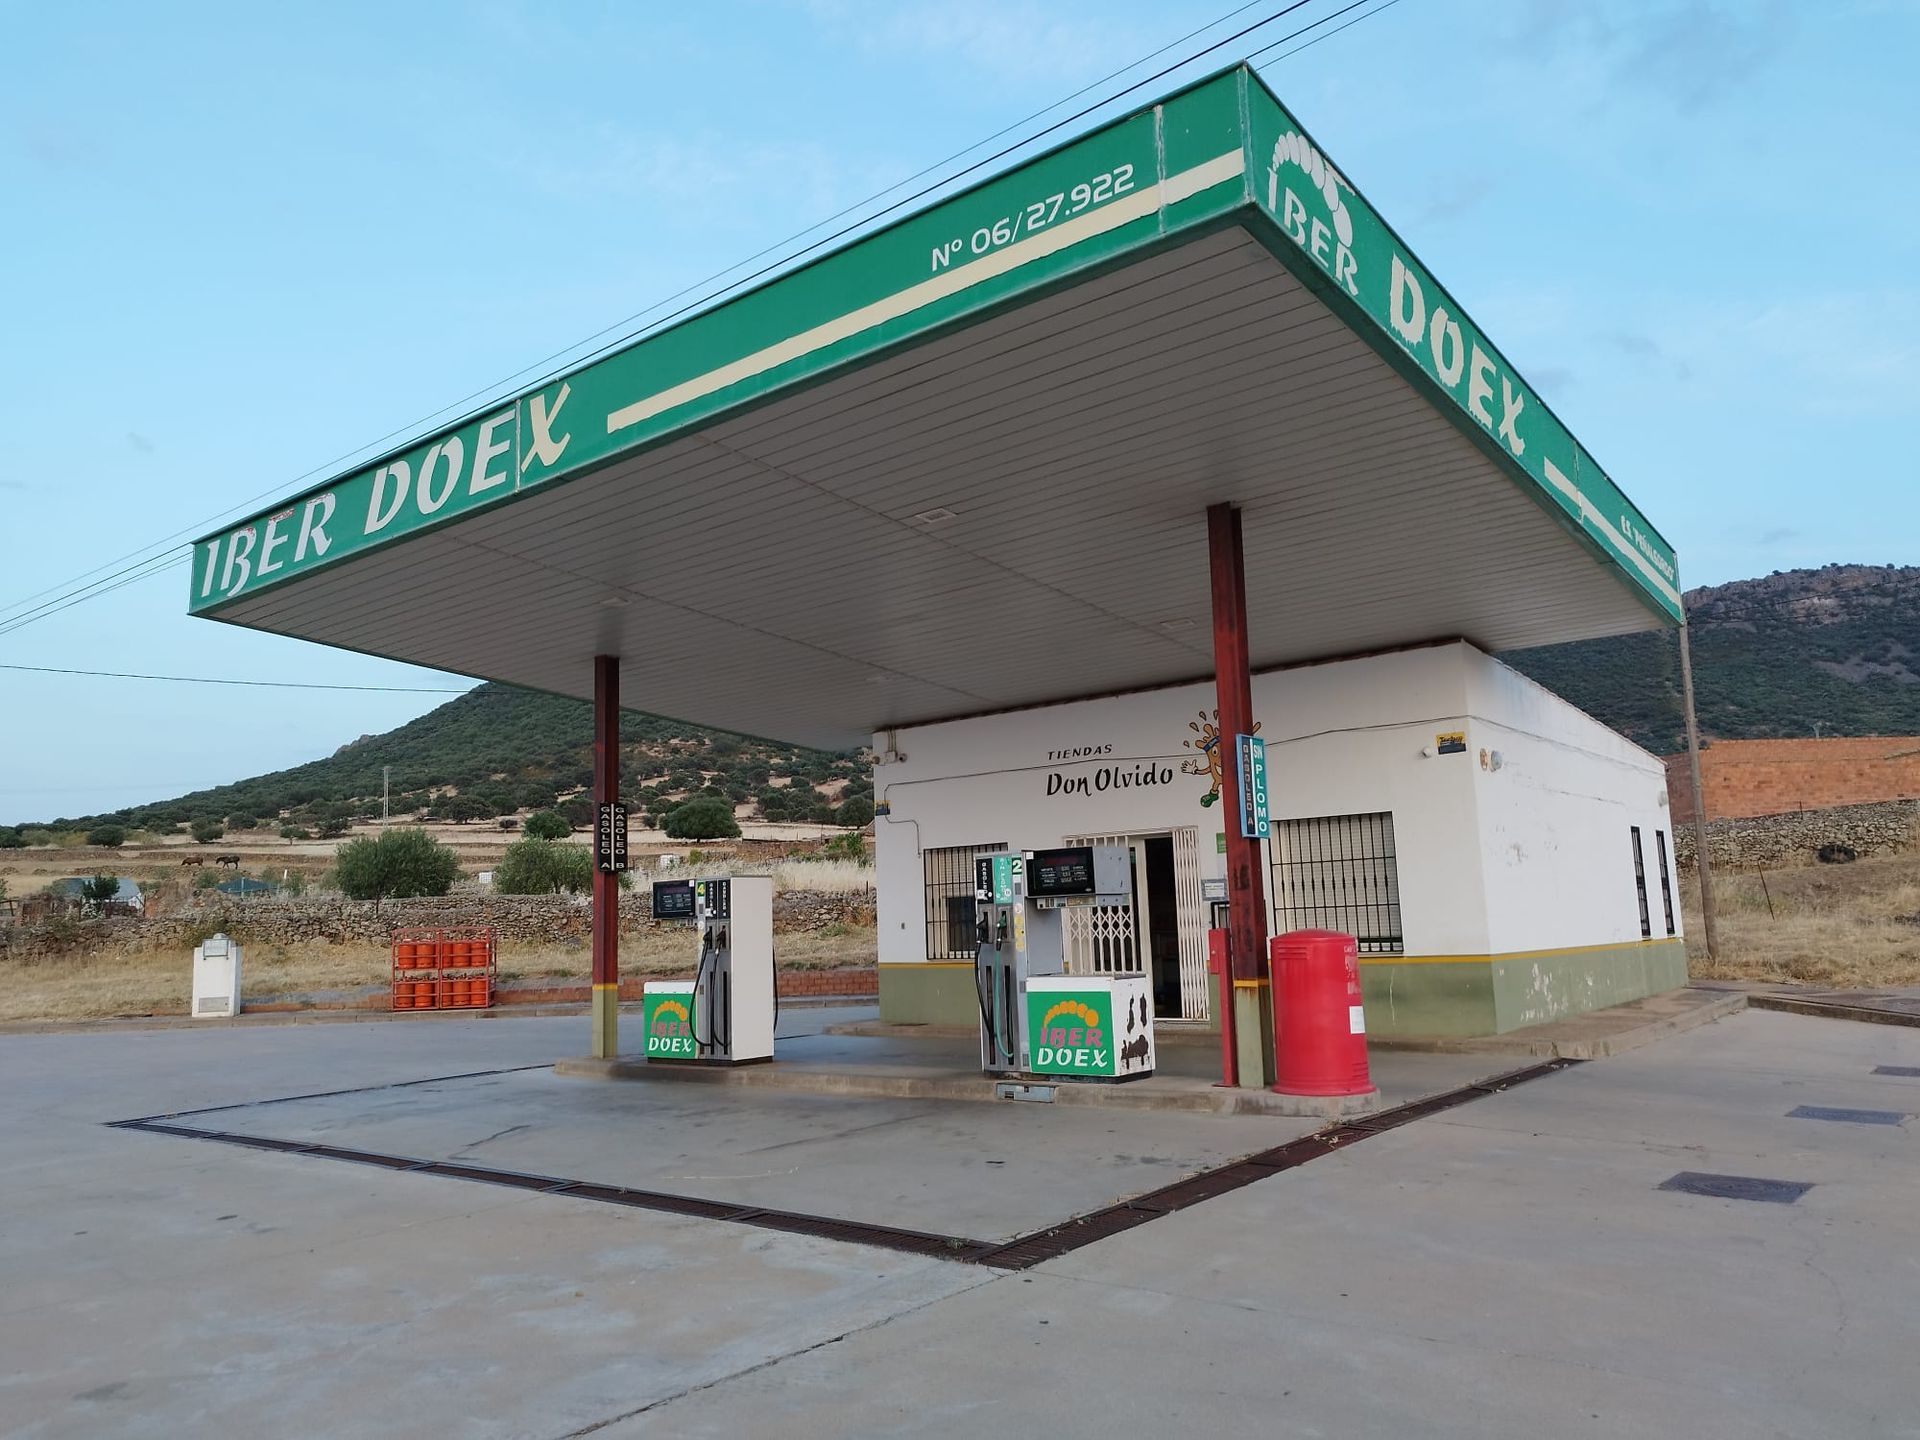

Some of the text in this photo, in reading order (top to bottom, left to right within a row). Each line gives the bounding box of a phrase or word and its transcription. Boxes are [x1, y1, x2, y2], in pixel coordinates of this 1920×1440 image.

[971, 164, 1135, 254] 06/27.922
[1267, 167, 1525, 456] IBER DOEX
[201, 382, 571, 598] IBER DOEX
[1047, 744, 1113, 761] TIENDAS
[1046, 762, 1173, 797] Don Olvido
[1242, 744, 1254, 825] GASOLEO A
[1253, 744, 1267, 832] SIN PLOMO
[600, 806, 610, 855] GASOLEO
[615, 807, 625, 855] GASOLEO
[1012, 859, 1022, 873] 2
[697, 883, 705, 895] 4
[648, 1037, 692, 1053] DOEX
[651, 1021, 690, 1038] IBER
[1040, 1027, 1103, 1049] IBER
[1037, 1047, 1108, 1068] DOEX
